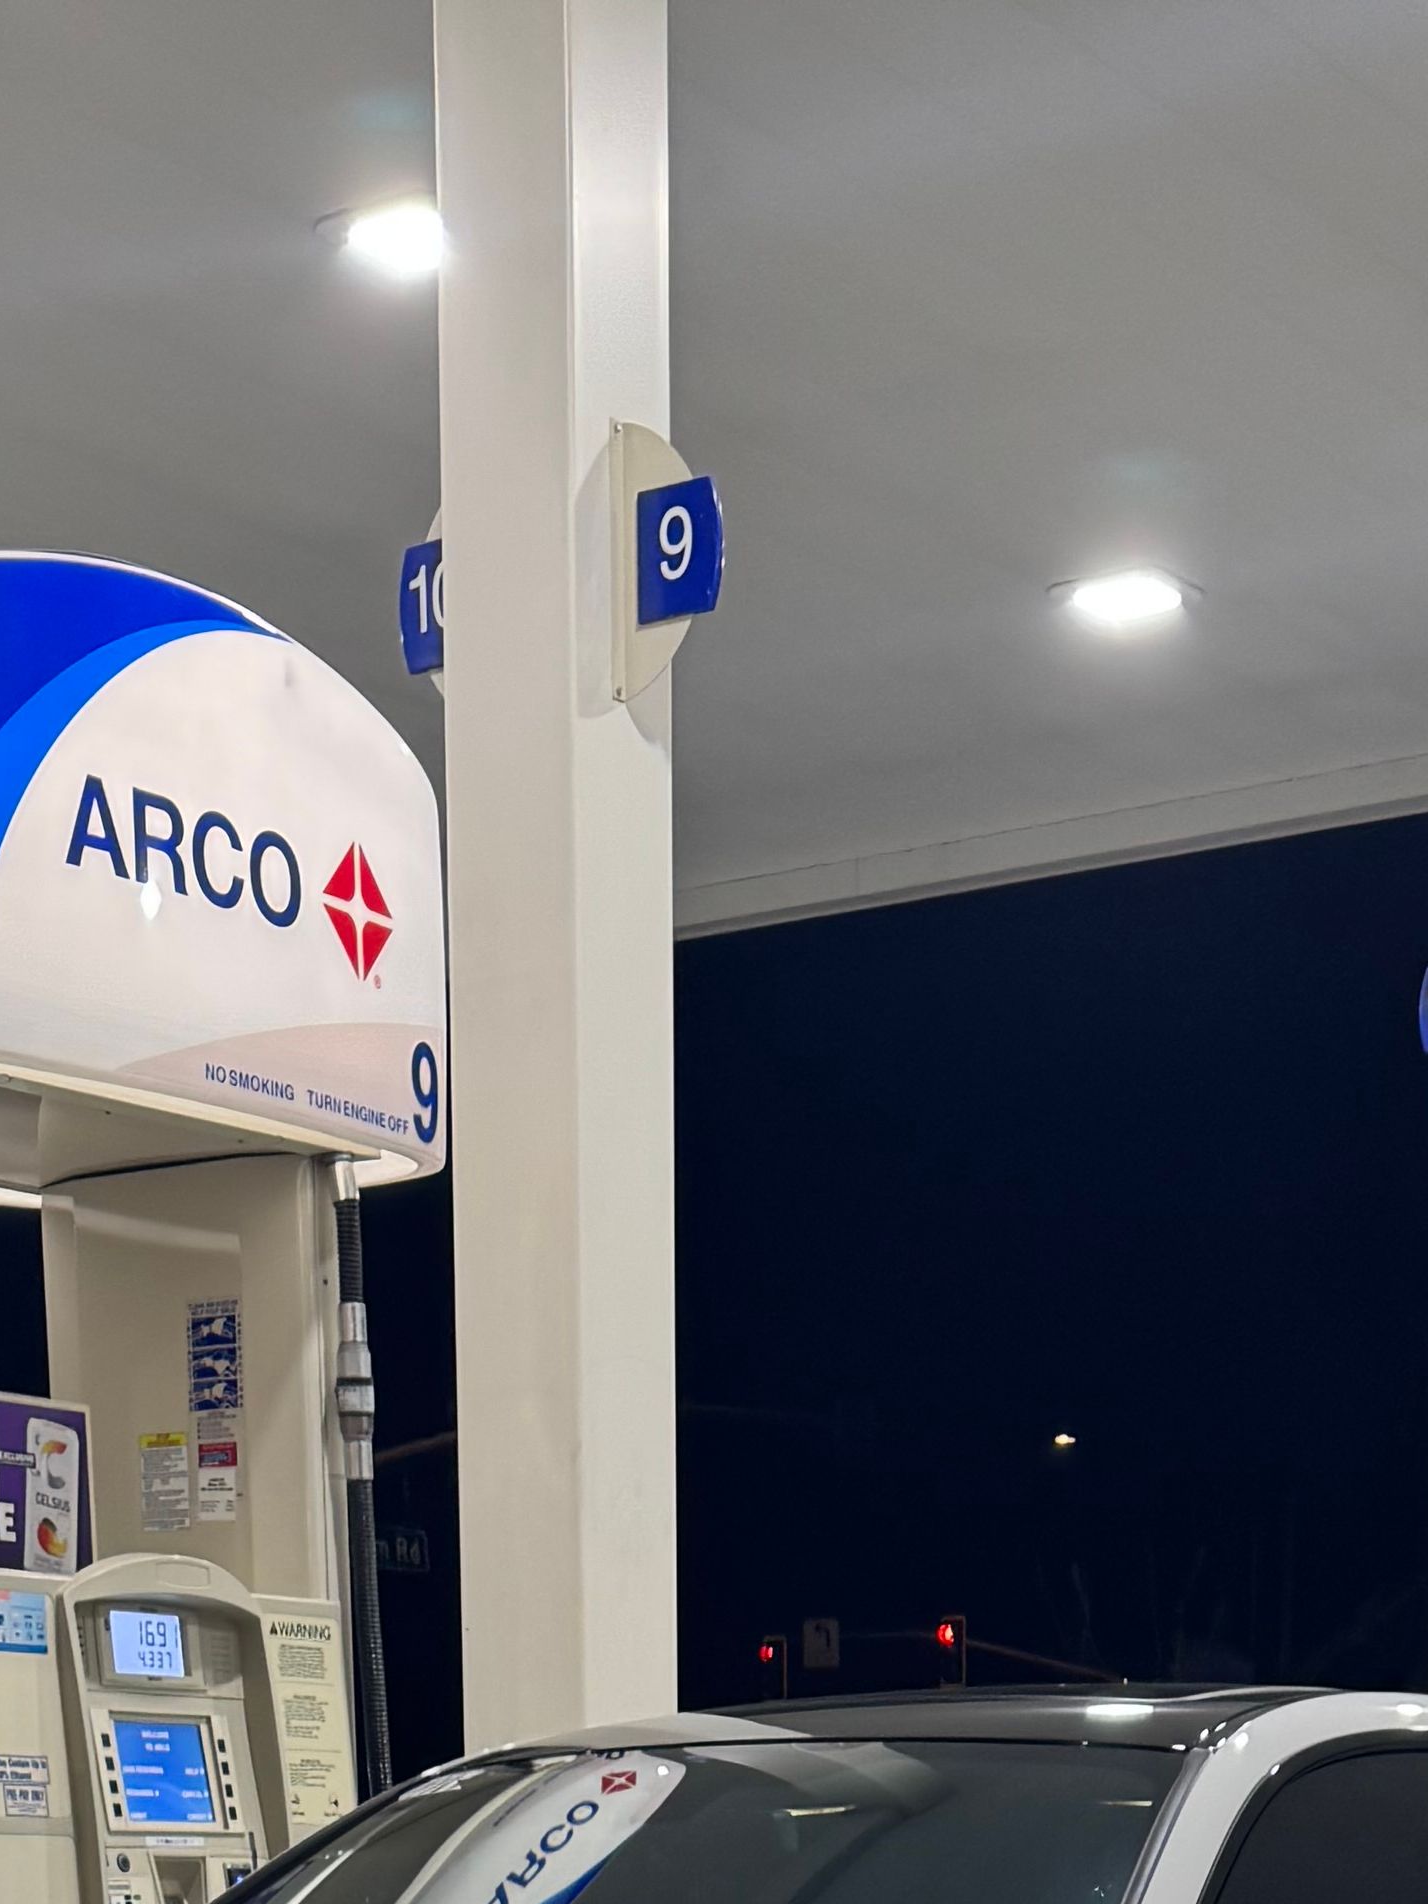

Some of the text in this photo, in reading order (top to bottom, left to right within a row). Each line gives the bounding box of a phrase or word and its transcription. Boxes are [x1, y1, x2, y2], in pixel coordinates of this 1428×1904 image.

[659, 505, 693, 580] 9
[65, 774, 302, 927] ARCO
[205, 1062, 409, 1135] NO SMOKING TURN ENGINE OFF
[411, 1041, 438, 1144] 9
[277, 1620, 332, 1641] WARNING
